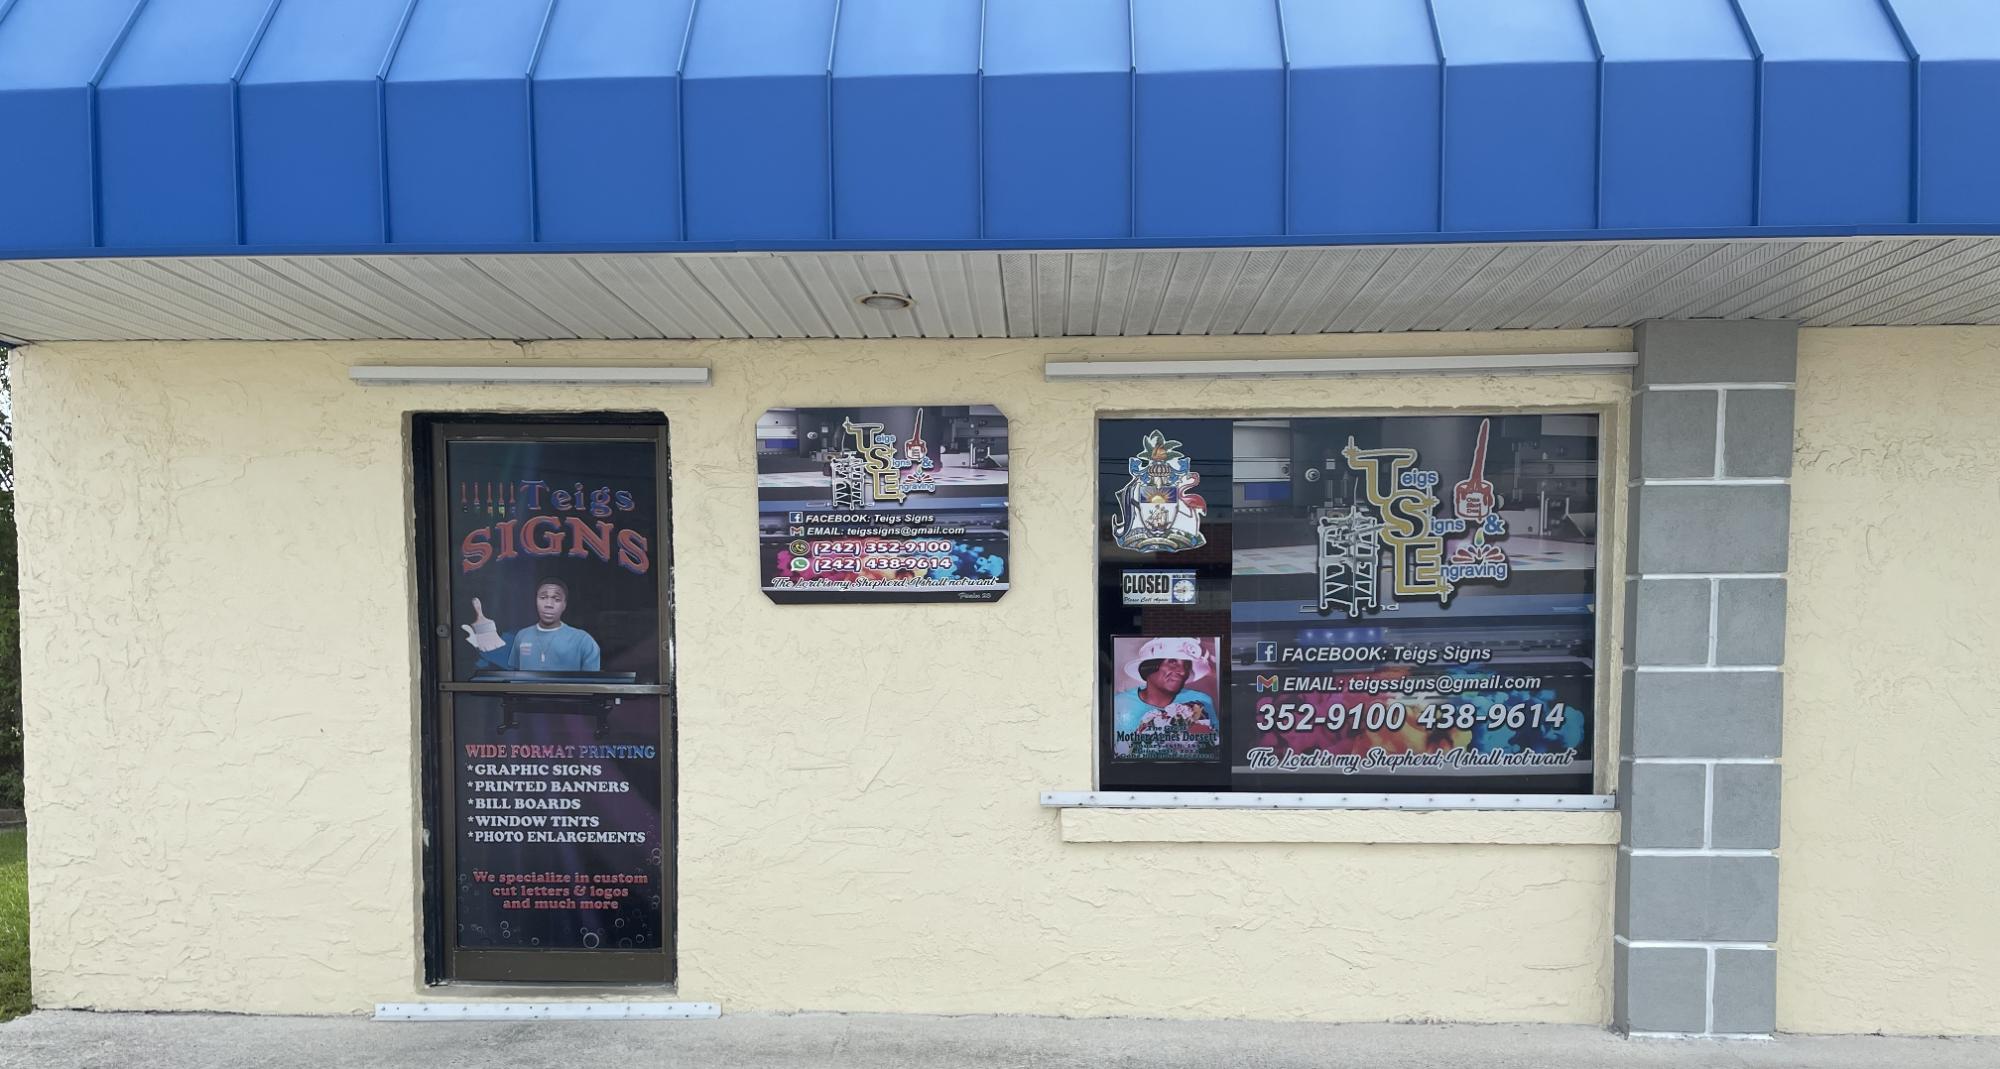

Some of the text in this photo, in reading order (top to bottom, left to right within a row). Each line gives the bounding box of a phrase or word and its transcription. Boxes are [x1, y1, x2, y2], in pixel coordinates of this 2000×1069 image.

[920, 456, 934, 469] &
[520, 480, 635, 517] Teigs
[805, 514, 934, 524] FACEBOOK: Teigs Signs
[1484, 515, 1506, 534] &
[806, 526, 966, 537] EMAIL: teigssigns@gmail.com
[461, 515, 650, 575] SIGNS
[813, 540, 951, 556] (242) 352-9100
[814, 557, 952, 571] (242) 438-9614
[771, 576, 793, 588] The
[793, 577, 822, 589] Lord
[822, 578, 833, 587] is
[833, 580, 851, 592] my
[920, 576, 948, 587] shall
[947, 577, 966, 586] not
[965, 576, 999, 587] want
[1123, 574, 1170, 594] CLOSED
[1282, 645, 1491, 663] FACEBOOK: Teigs Signs
[1283, 675, 1541, 694] EMAIL: teigssigns@gmail.com
[1256, 702, 1565, 731] 352-9100 438-9614
[1116, 730, 1218, 743] Mother Agnes Dorsett
[465, 744, 656, 758] WIDE FORMAT PRINTING
[1247, 747, 1279, 770] The
[1279, 748, 1320, 771] Lord
[1319, 748, 1335, 768] is
[1335, 753, 1361, 775] my
[1462, 748, 1503, 768] shall
[1502, 748, 1530, 767] not
[1530, 748, 1577, 767] want
[553, 764, 602, 776] SIGNS
[551, 781, 630, 793] BANNERS
[515, 798, 581, 810] BOARDS
[551, 815, 600, 828] TINTS
[527, 831, 646, 843] ENLARGEMENTS
[473, 871, 648, 885] We specialize in custom
[492, 885, 629, 899] cut letters & logos
[503, 898, 619, 909] and much more
